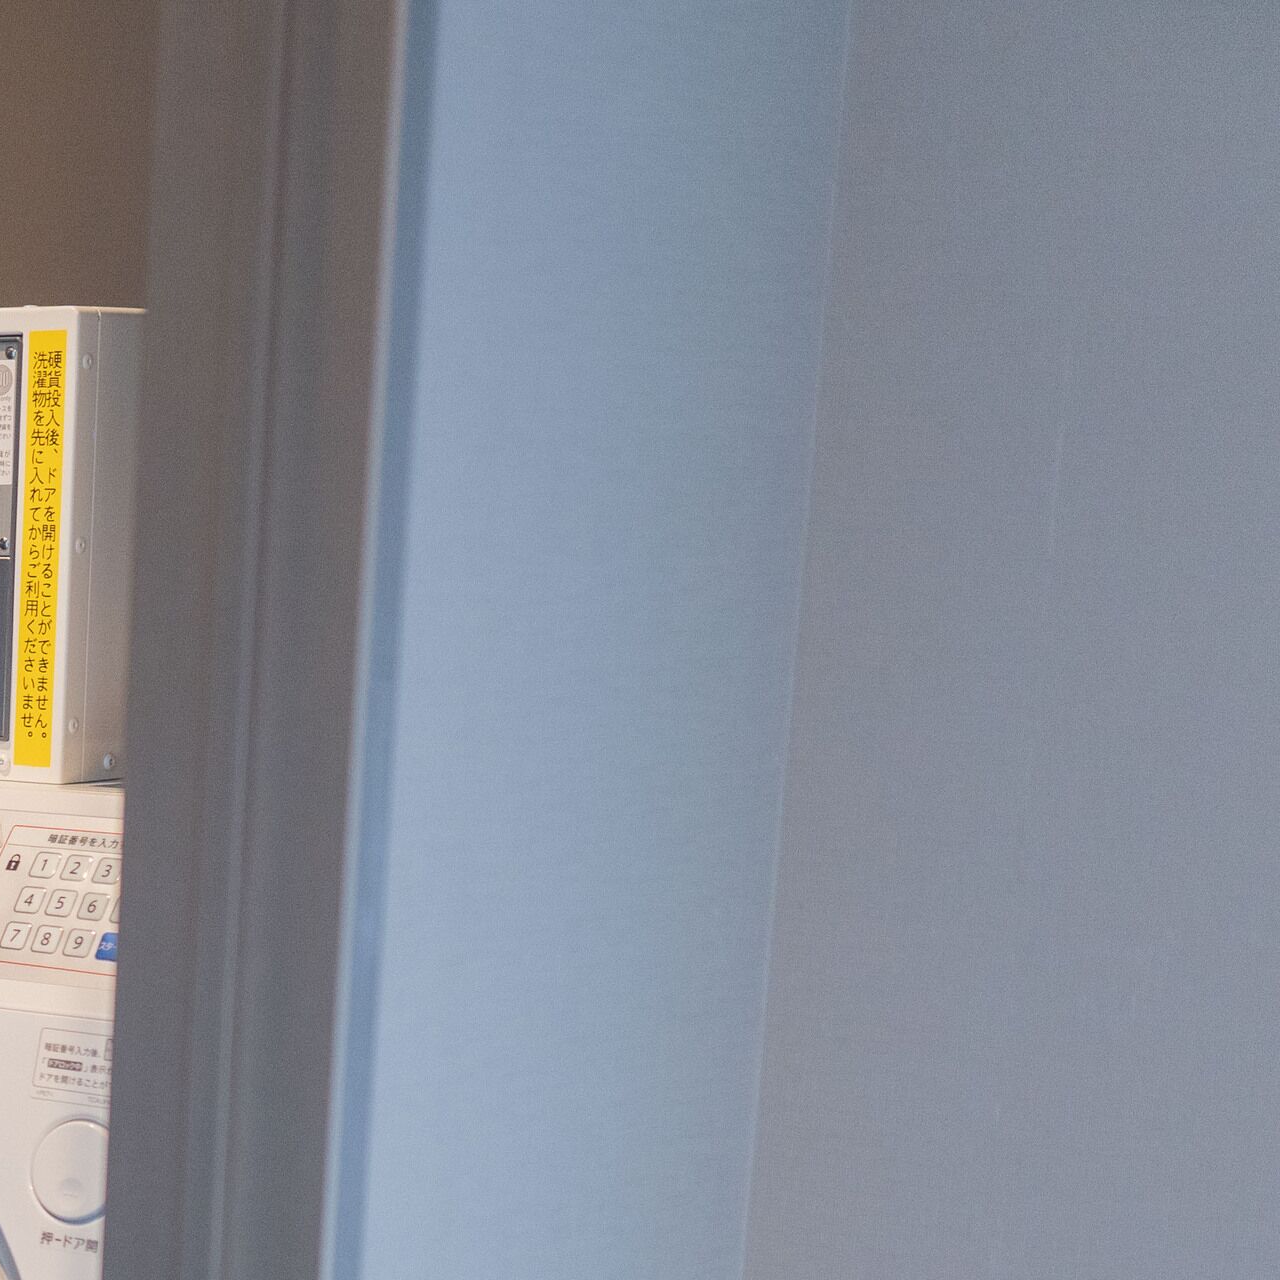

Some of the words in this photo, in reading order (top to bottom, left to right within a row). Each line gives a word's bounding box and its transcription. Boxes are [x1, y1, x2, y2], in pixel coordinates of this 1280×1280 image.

[48, 833, 120, 849] 暗証番号を入力
[70, 862, 81, 874] 2
[101, 864, 113, 877] 3
[24, 893, 34, 907] 4
[55, 896, 67, 909] 5
[87, 900, 98, 913] 6
[11, 929, 21, 942] 7
[41, 932, 52, 946] 8
[73, 936, 84, 949] 9
[40, 1072, 111, 1089] ドアを開けることが
